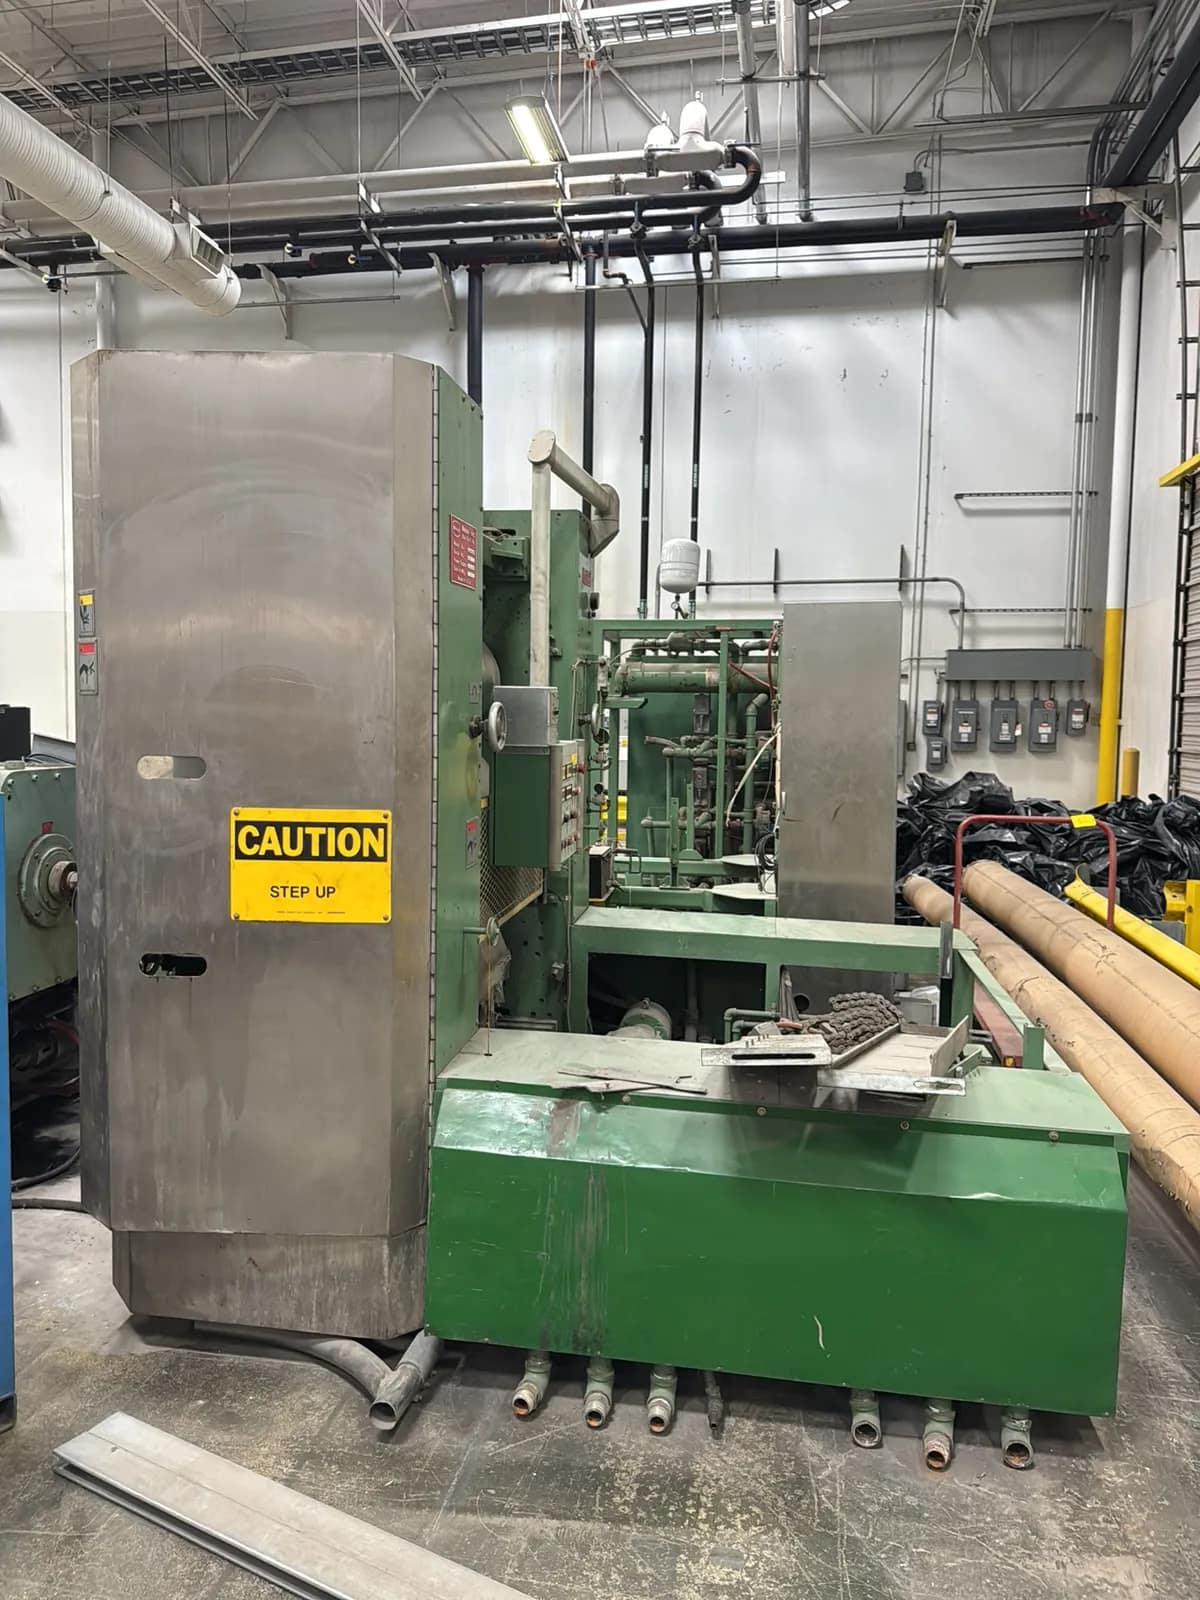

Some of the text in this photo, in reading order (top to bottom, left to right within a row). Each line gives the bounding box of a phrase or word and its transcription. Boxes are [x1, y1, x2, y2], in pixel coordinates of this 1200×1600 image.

[238, 825, 384, 857] CAUTION
[270, 885, 336, 898] STEP UP
